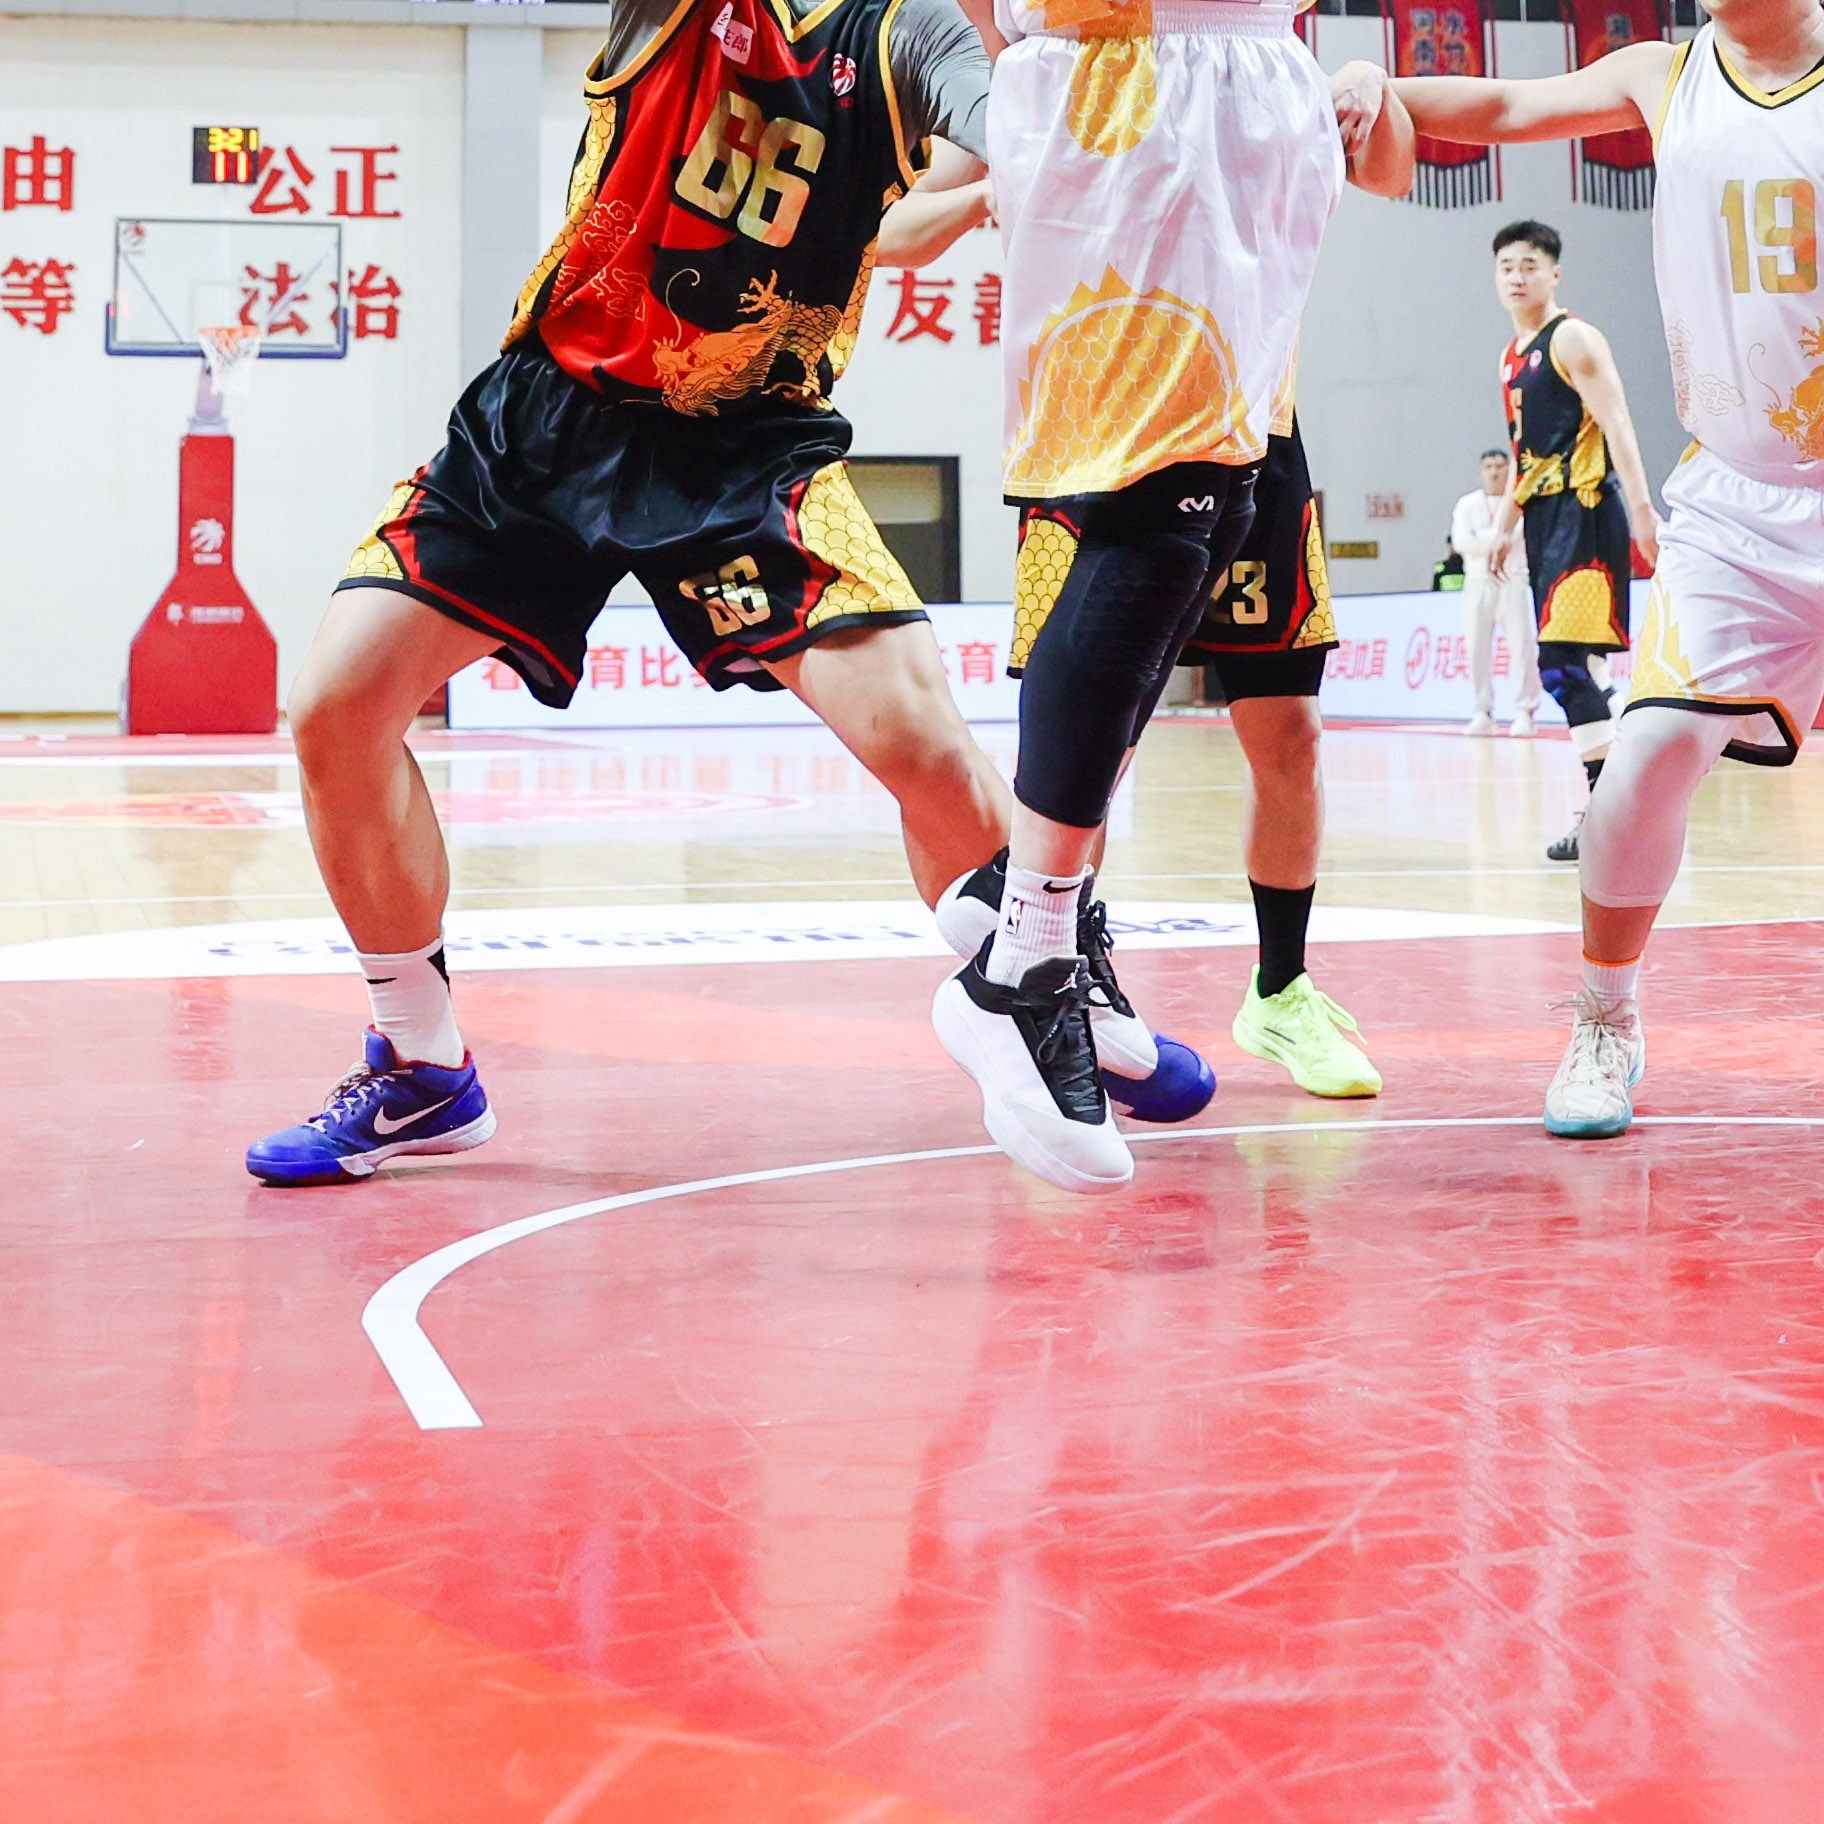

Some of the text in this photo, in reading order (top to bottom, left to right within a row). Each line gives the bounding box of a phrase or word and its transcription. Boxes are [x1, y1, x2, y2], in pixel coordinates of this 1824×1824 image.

[246, 144, 402, 218] 公正
[675, 90, 825, 248] 66
[1720, 177, 1818, 294] 19
[238, 262, 402, 339] 法治
[678, 555, 771, 636] 66
